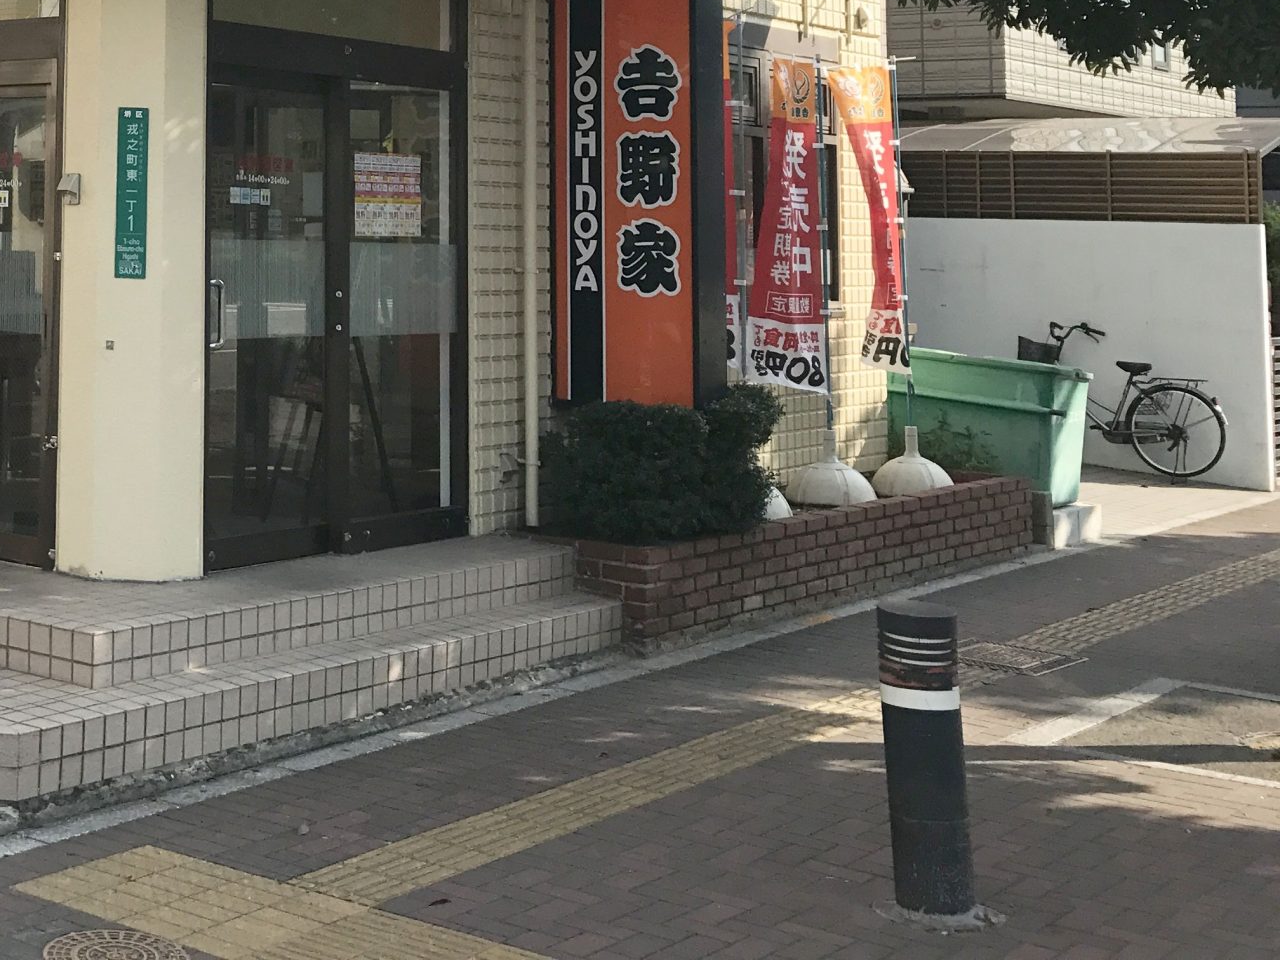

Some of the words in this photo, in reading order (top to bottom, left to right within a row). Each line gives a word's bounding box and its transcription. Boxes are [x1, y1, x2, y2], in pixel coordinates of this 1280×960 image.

[574, 50, 598, 292] YOSHINOYA
[615, 43, 681, 298] 吉野家
